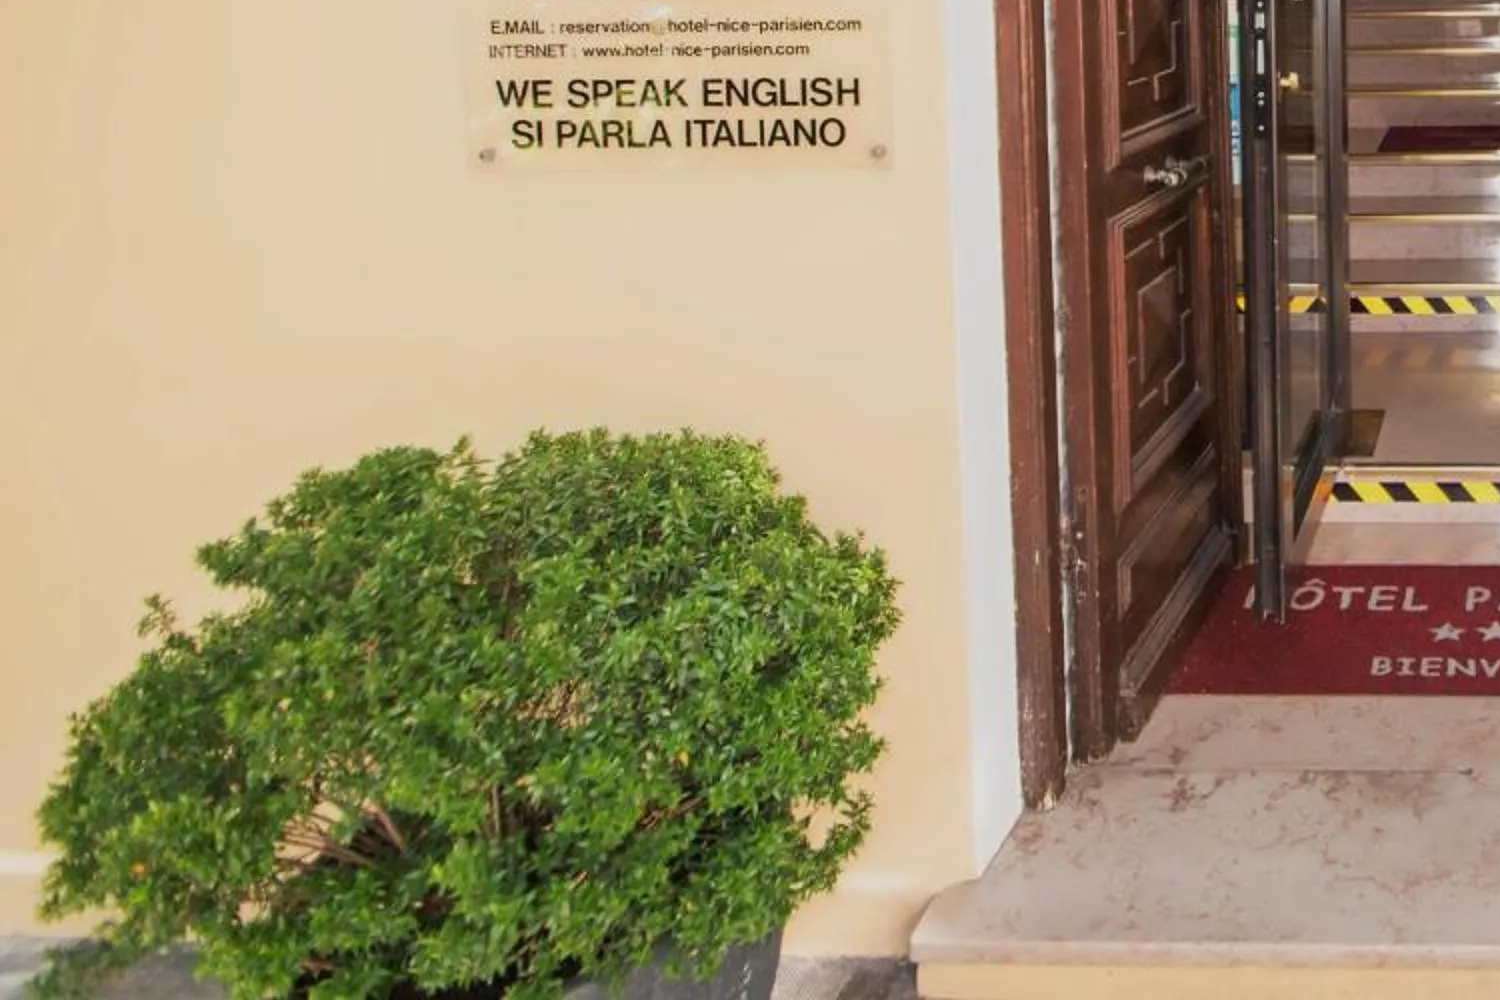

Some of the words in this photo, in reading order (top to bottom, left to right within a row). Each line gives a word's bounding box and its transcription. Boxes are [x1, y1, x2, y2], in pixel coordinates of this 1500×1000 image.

[559, 17, 862, 36] reservationhotel-nice-parisien.com
[489, 44, 567, 58] INTERNET
[496, 80, 553, 108] WE
[566, 78, 688, 107] SPEAK
[703, 77, 860, 106] ENGLISH
[512, 120, 543, 149] SI
[557, 119, 672, 148] PARLA
[685, 118, 845, 147] ITALIANO
[1243, 578, 1428, 612] ÔTEL
